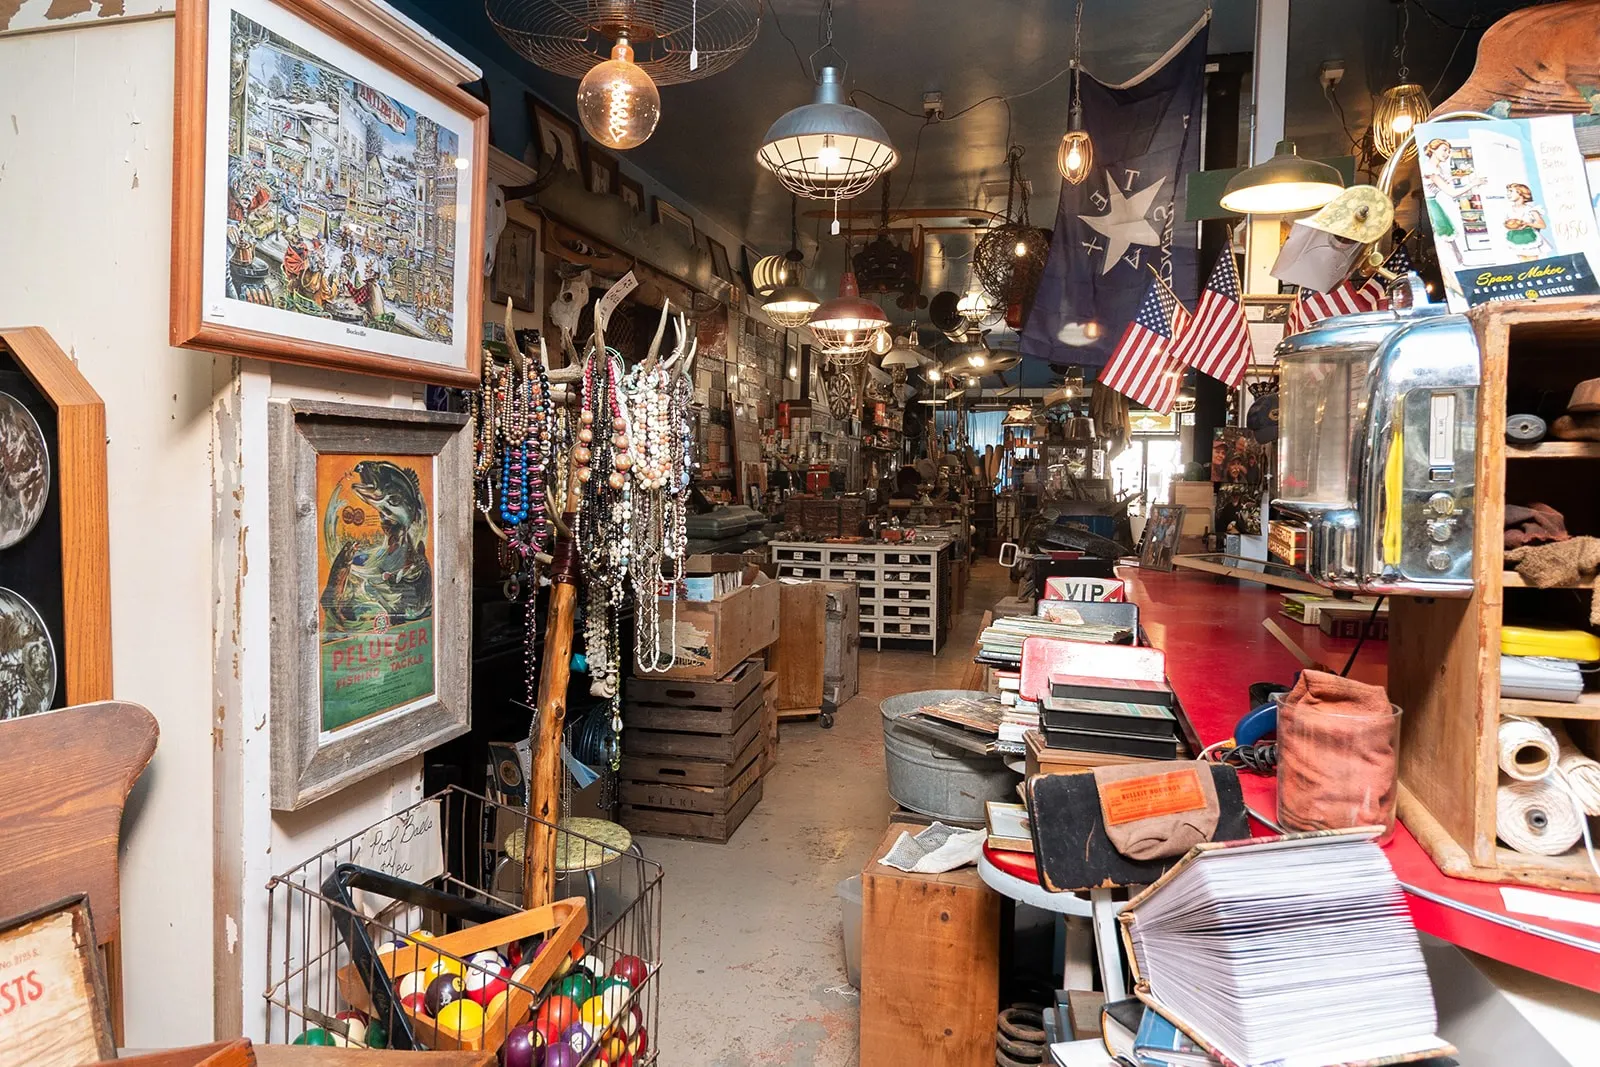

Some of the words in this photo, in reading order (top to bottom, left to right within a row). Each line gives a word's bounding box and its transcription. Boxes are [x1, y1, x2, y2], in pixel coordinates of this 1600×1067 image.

[1473, 273, 1583, 294] REFRIGERATOR
[1476, 272, 1513, 286] Space
[1518, 264, 1566, 281] Maker
[1538, 285, 1576, 297] ELECTRIC
[1065, 583, 1105, 603] VIP
[332, 628, 428, 673] PFLUEGER
[335, 667, 381, 692] FISHING
[390, 654, 425, 673] TACKLE
[370, 826, 400, 858] Pool
[400, 815, 433, 843] Balls
